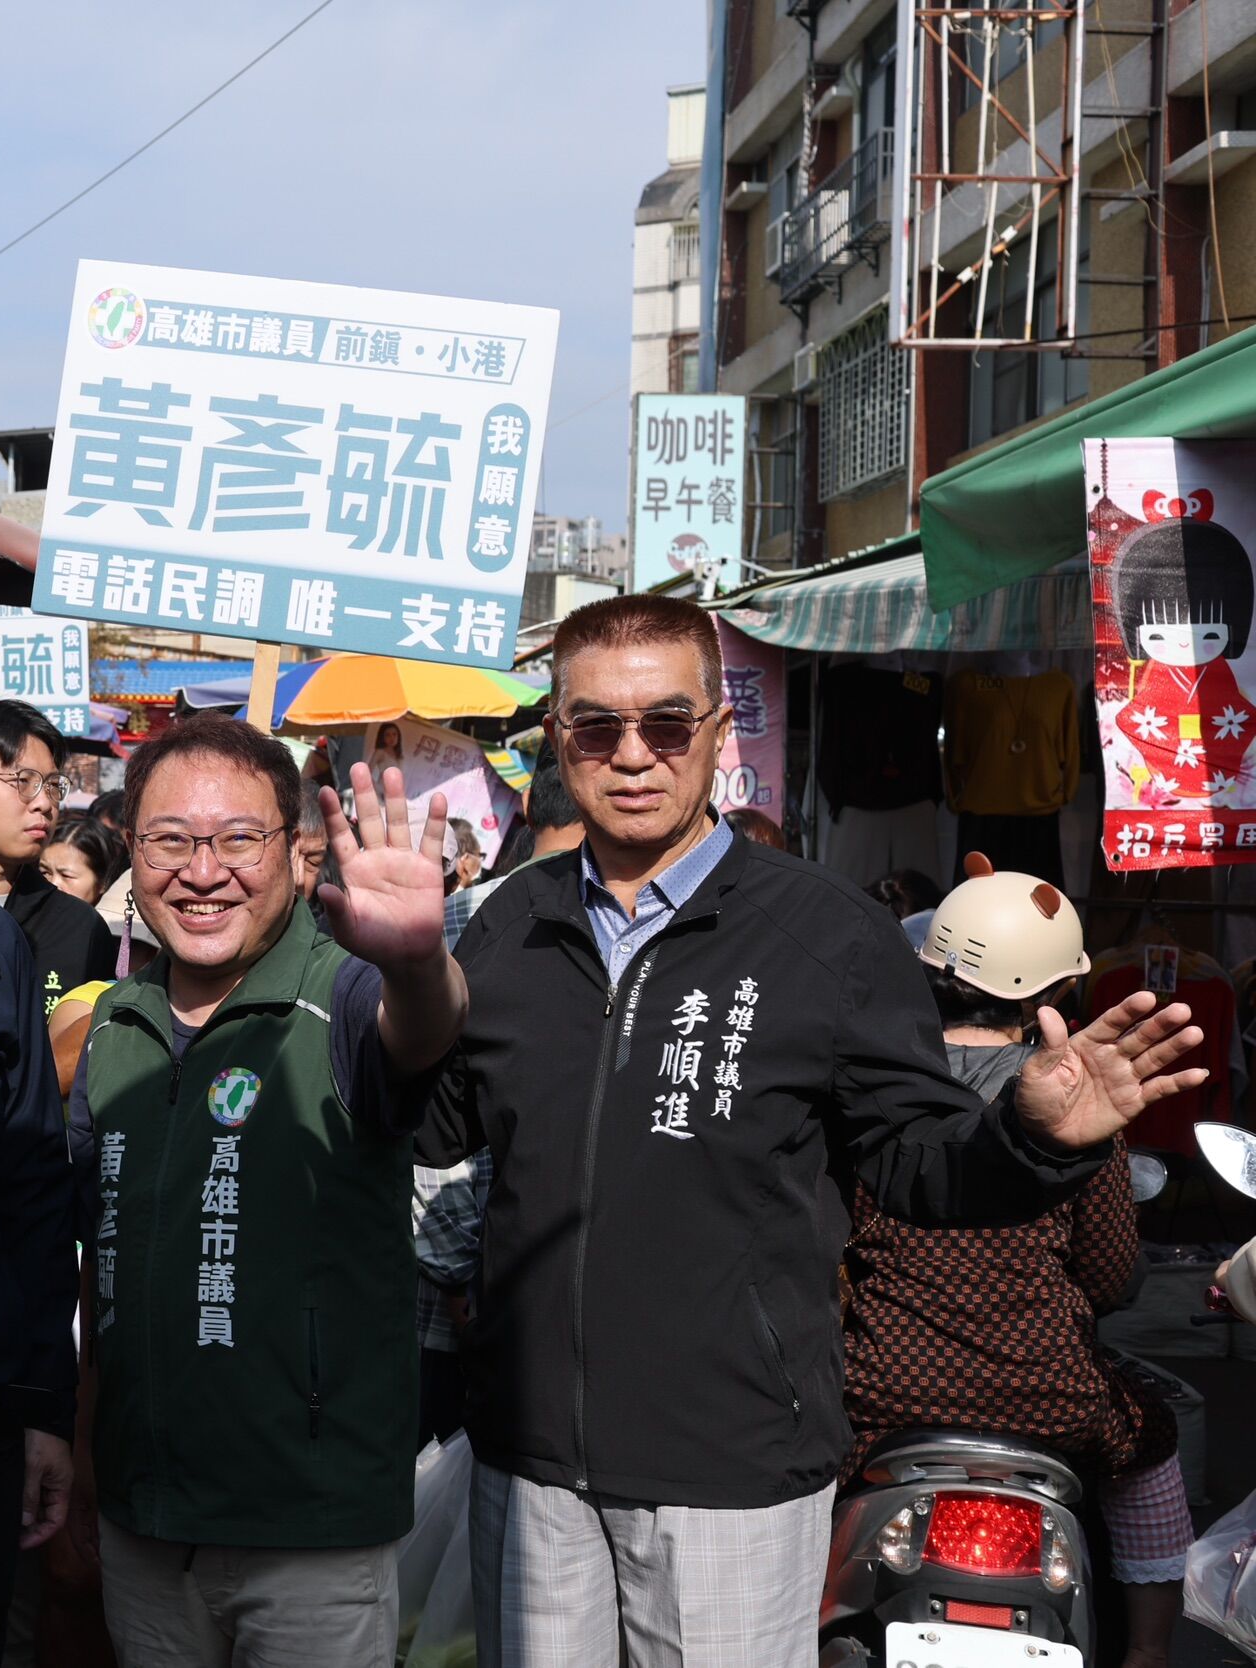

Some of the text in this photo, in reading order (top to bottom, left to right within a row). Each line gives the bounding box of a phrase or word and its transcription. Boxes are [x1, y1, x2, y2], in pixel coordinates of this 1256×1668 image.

[147, 305, 316, 359] 高雄市議員
[646, 407, 735, 467] 咖啡
[473, 413, 526, 559] 我願意
[641, 475, 737, 524] 早午餐
[50, 549, 505, 660] 電話民調 唯一支持
[63, 629, 81, 691] 我願意
[622, 1012, 635, 1037] BEST
[627, 984, 642, 1010] YOUR
[650, 988, 711, 1140] 李順進
[710, 976, 760, 1121] 高雄市議員
[196, 1134, 242, 1348] 高雄市議員
